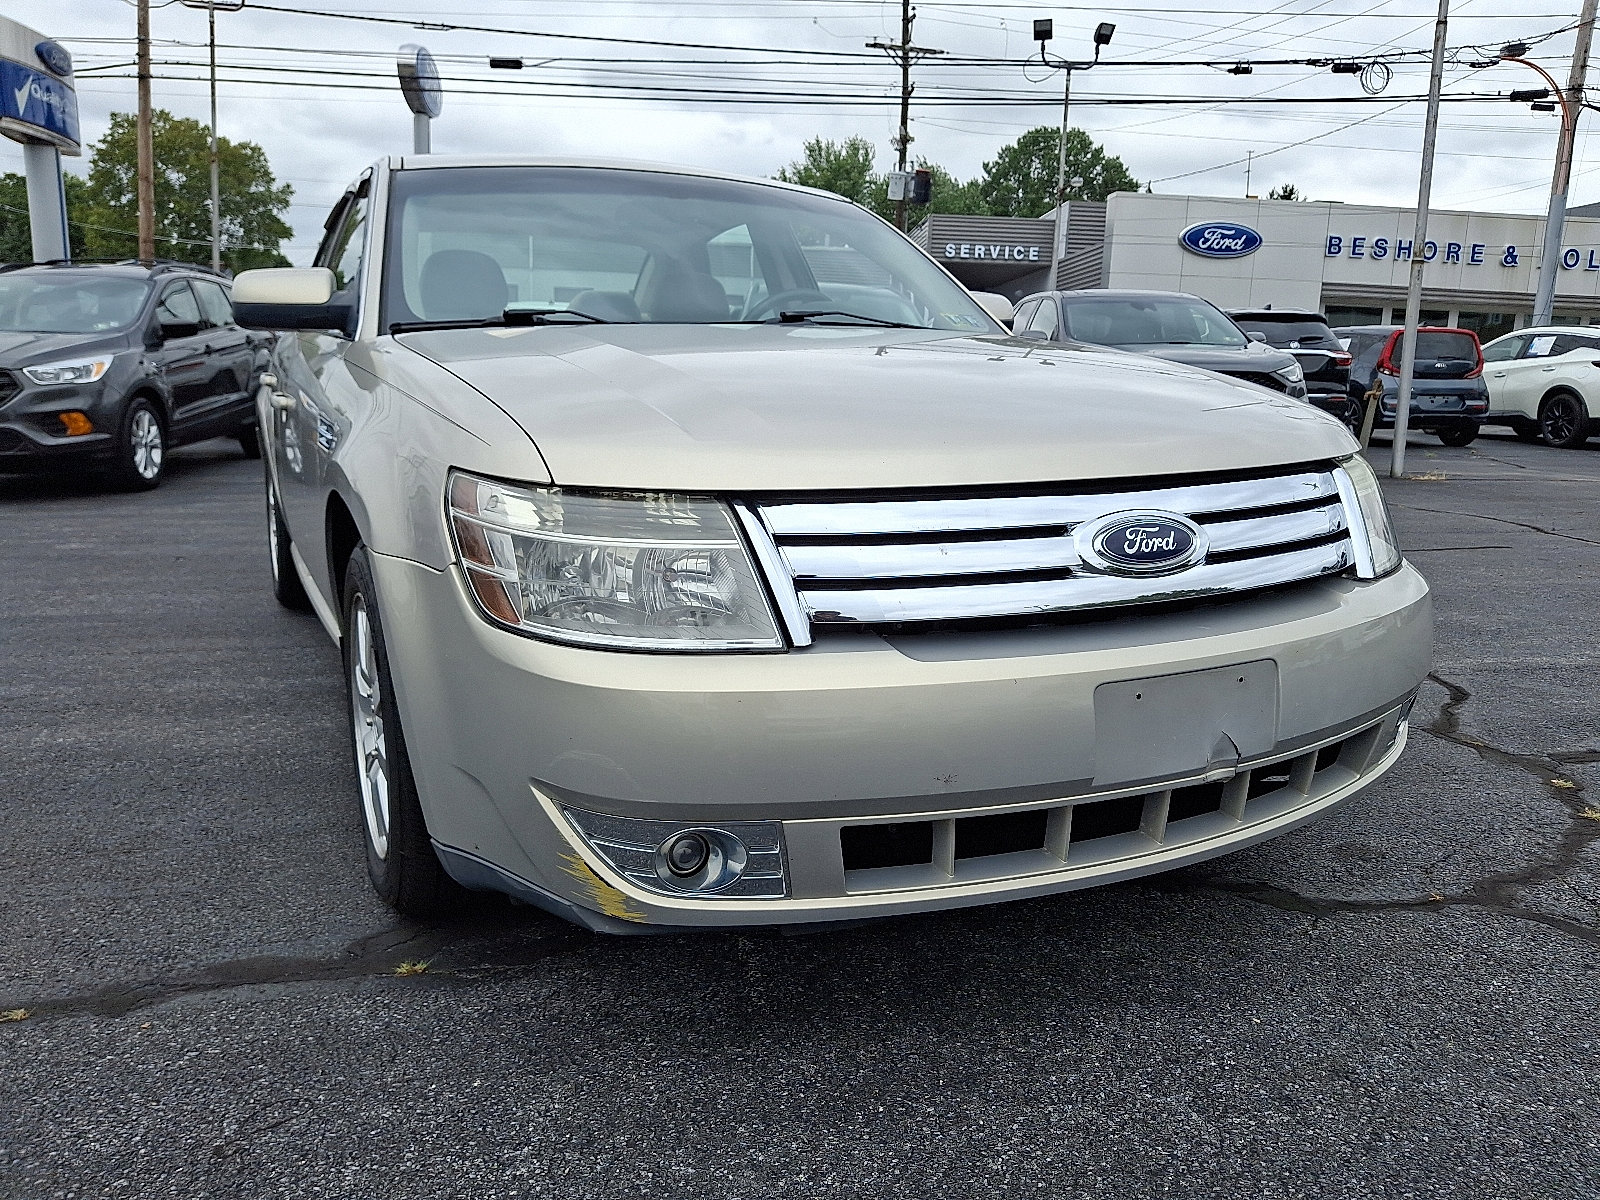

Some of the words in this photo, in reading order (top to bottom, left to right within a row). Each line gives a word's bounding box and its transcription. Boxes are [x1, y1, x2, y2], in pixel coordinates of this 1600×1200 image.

[1198, 228, 1247, 250] Ford
[944, 243, 1040, 261] SERVICE
[1326, 235, 1486, 264] BESHORE
[1503, 245, 1519, 266] &
[1563, 248, 1600, 269] OL
[1123, 526, 1177, 554] Ford
